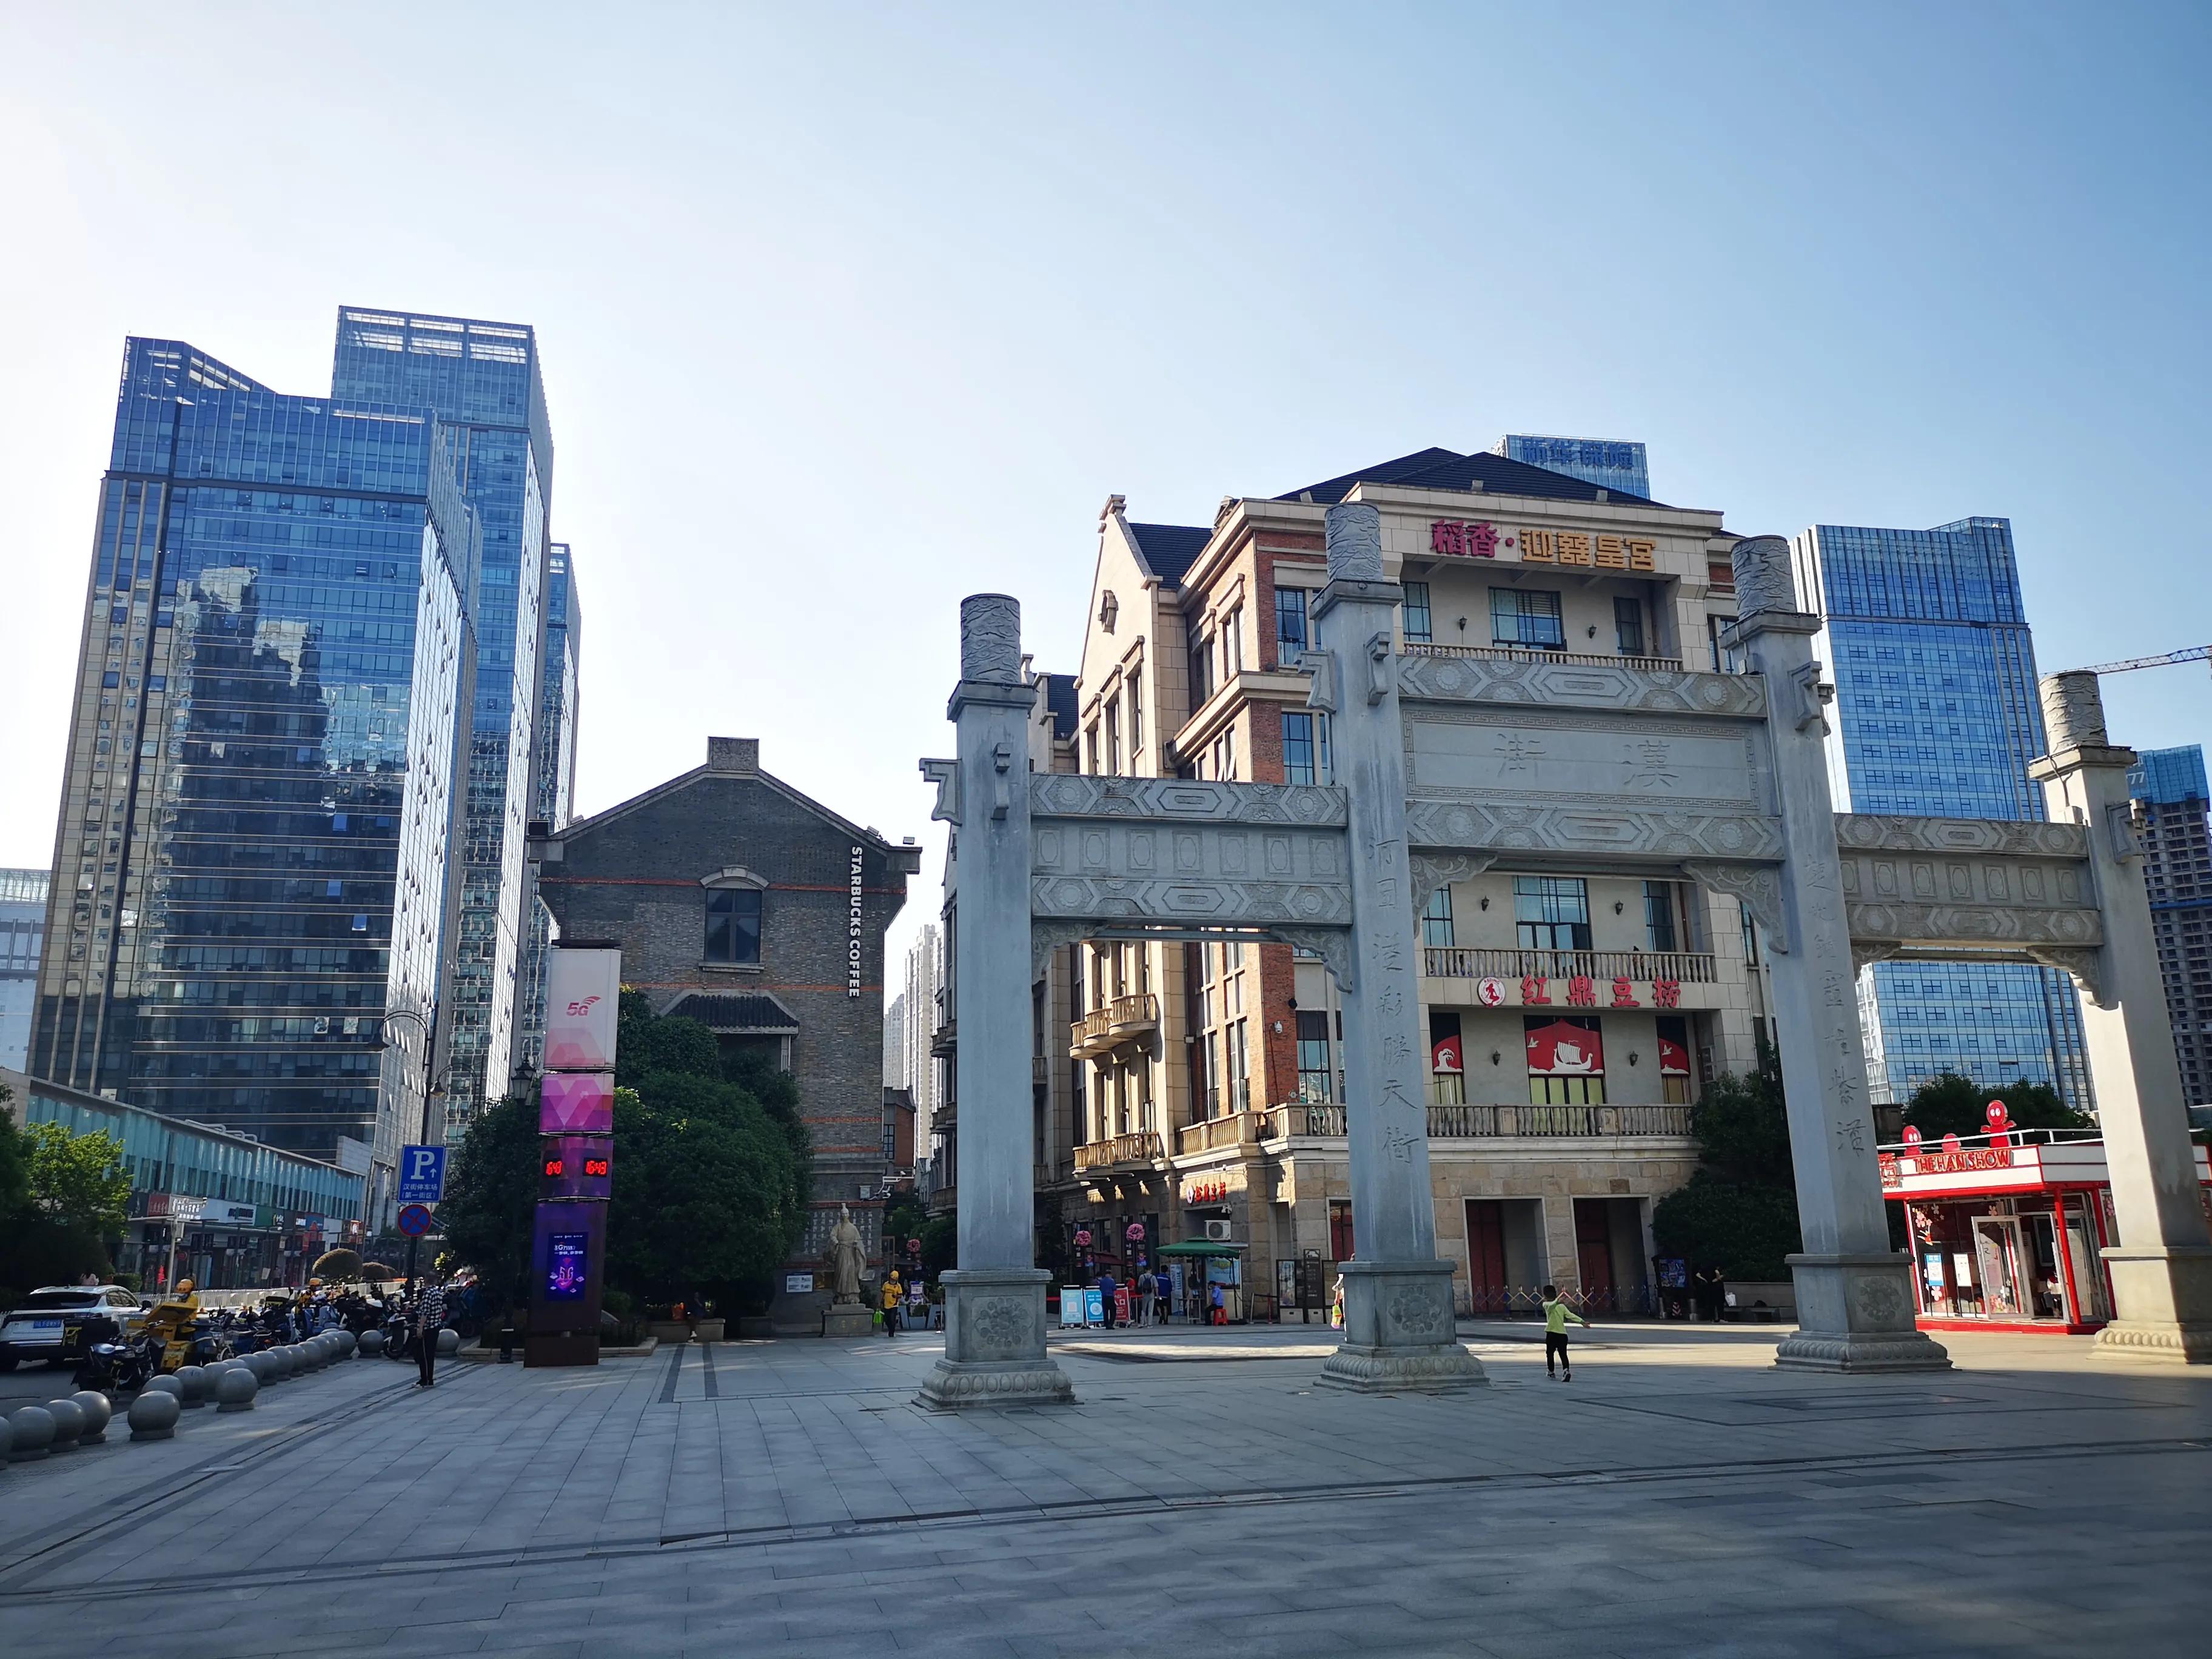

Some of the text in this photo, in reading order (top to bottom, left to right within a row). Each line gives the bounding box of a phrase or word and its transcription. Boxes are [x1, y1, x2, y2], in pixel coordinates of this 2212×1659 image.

[849, 846, 863, 997] STARBUCKS COFFEE
[1521, 973, 1681, 1008] 红鼎豆捞
[566, 1002, 589, 1016] 5G
[411, 1150, 435, 1180] P
[1913, 1155, 1935, 1174] THE
[1936, 1152, 1967, 1171] HAN
[1967, 1150, 2011, 1169] SHOW
[403, 1183, 438, 1191] 汉街停车场
